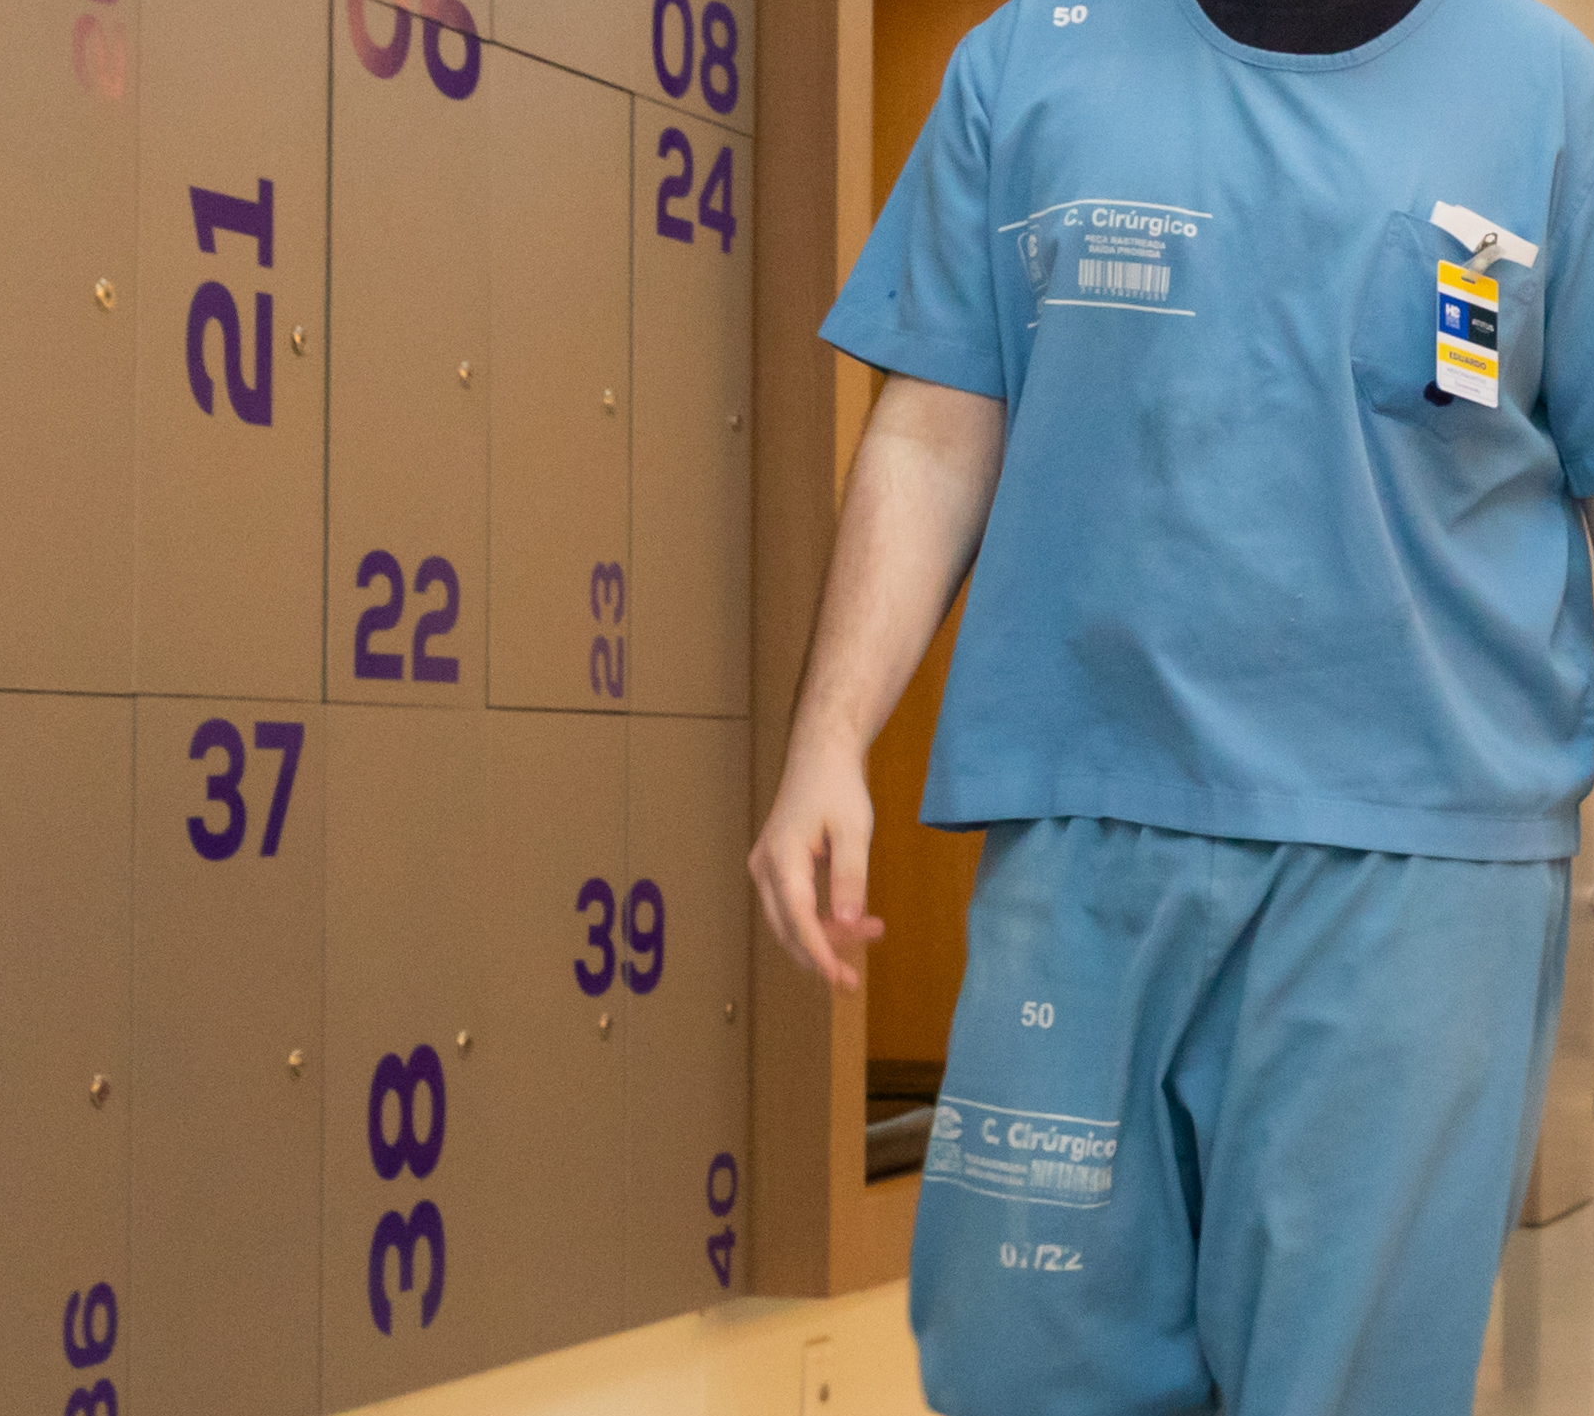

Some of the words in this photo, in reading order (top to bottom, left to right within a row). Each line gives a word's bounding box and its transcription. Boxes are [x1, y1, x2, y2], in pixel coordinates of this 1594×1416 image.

[1052, 5, 1088, 27] 50
[657, 128, 736, 253] 24
[1063, 208, 1084, 226] C.
[1091, 207, 1198, 237] Cirúrgico
[187, 179, 273, 426] 21
[355, 550, 459, 682] 22
[594, 565, 621, 696] 23
[187, 718, 304, 861] 37
[575, 879, 663, 995] 39
[1020, 1001, 1055, 1029] 50
[369, 1045, 445, 1334] 38
[1008, 1122, 1118, 1162] Cirúrgico
[708, 1153, 736, 1286] 40
